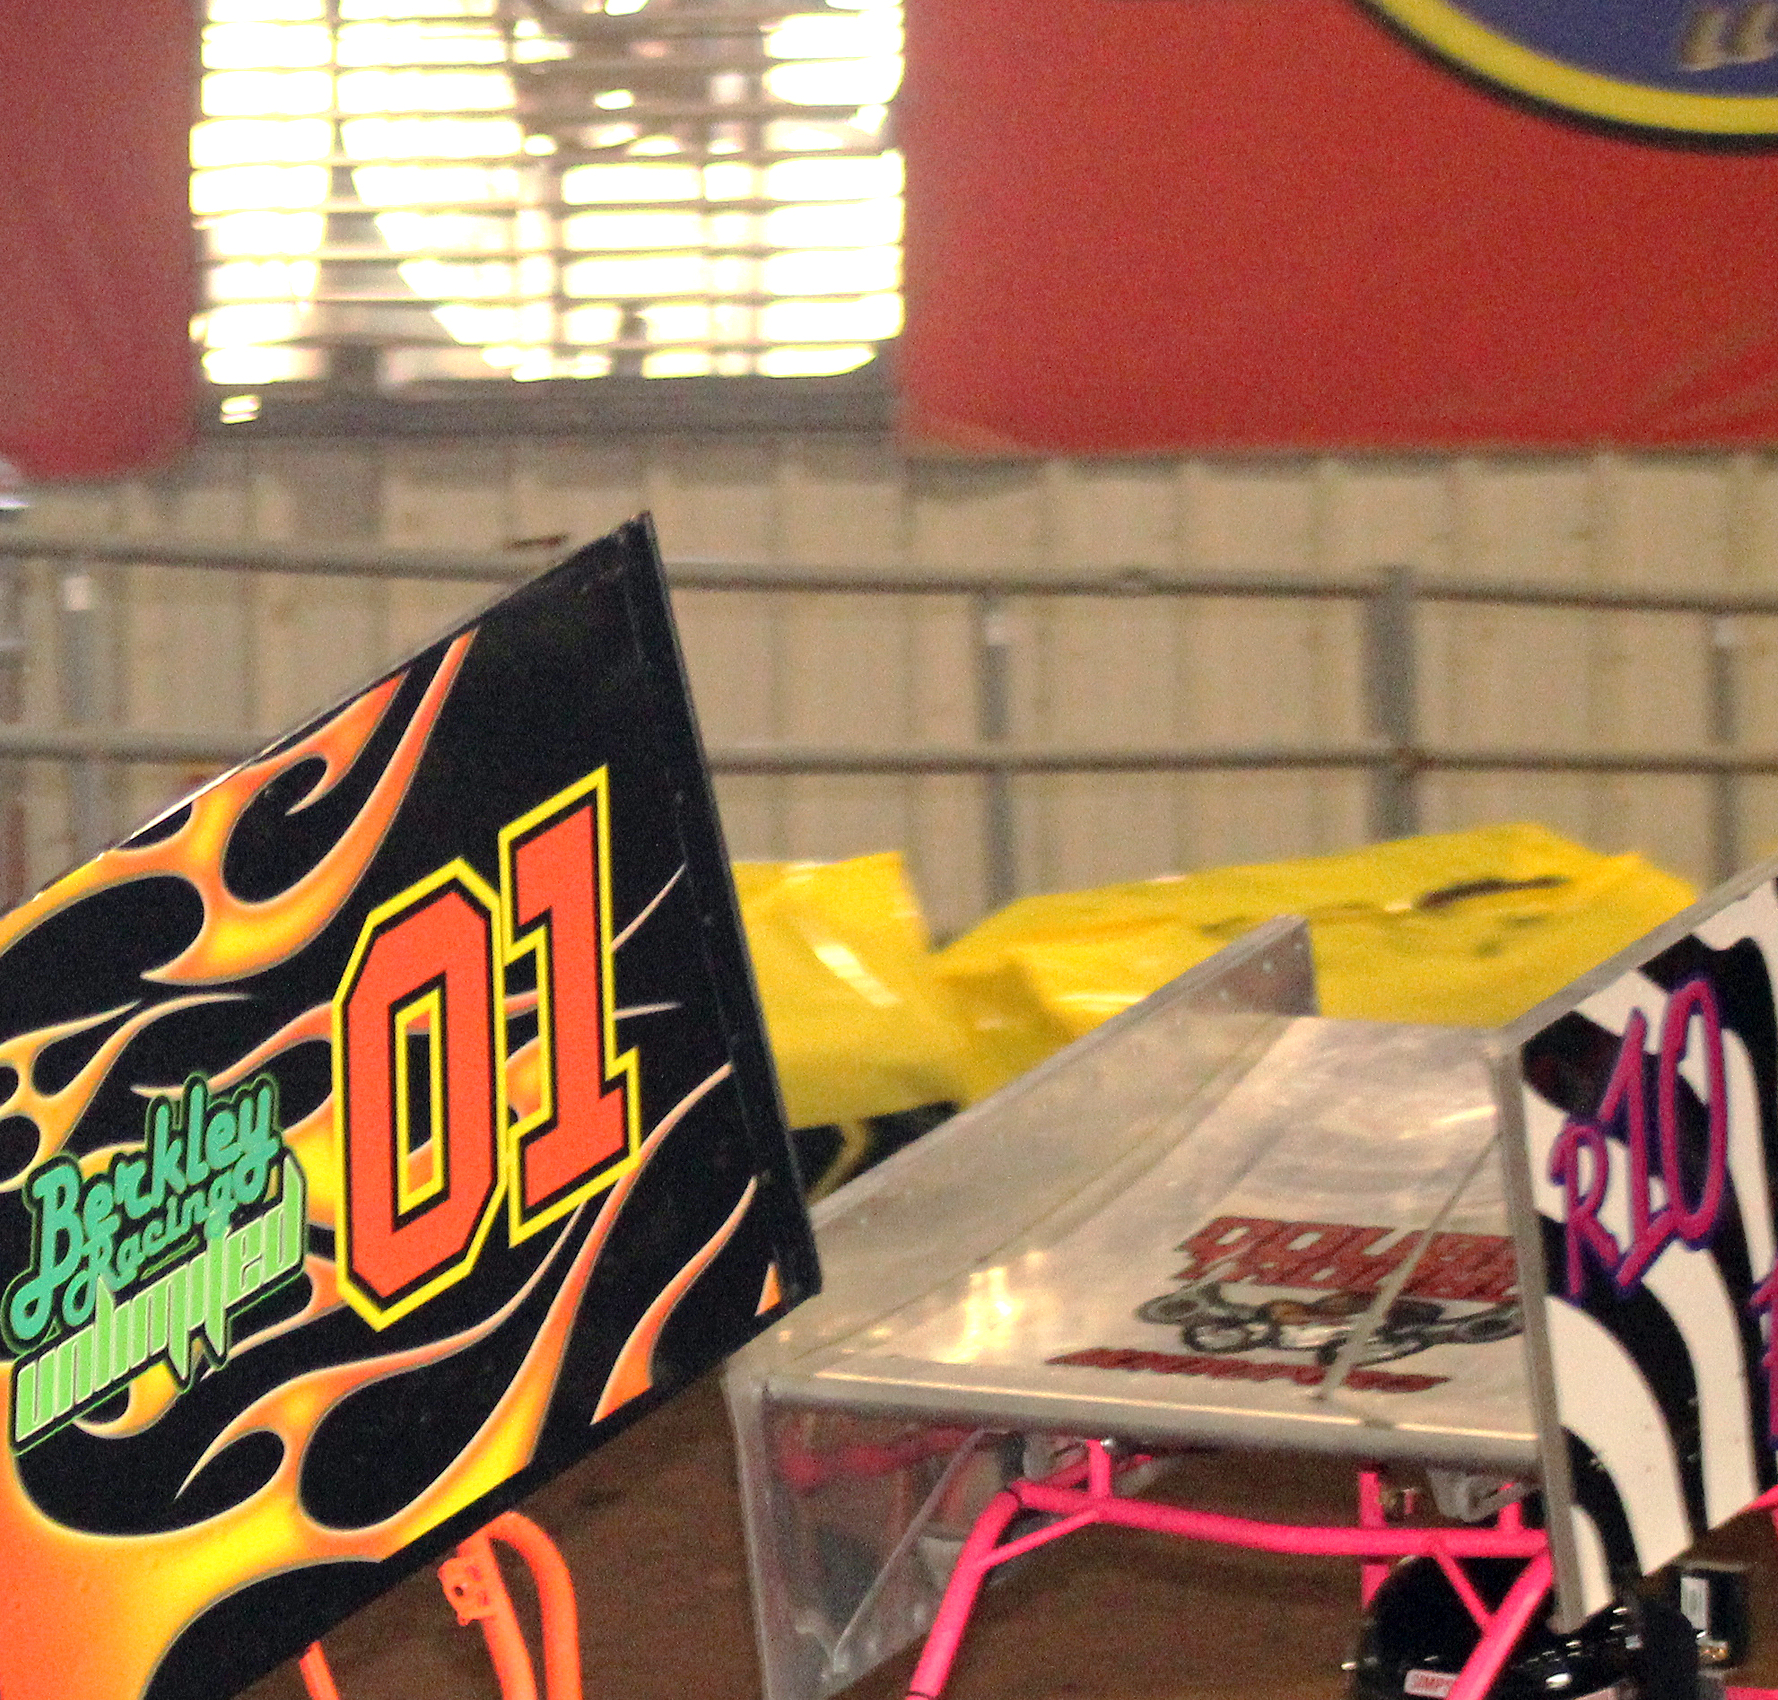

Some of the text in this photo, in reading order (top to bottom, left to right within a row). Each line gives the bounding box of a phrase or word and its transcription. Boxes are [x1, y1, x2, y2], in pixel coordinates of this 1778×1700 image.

[332, 764, 642, 1332] 01
[9, 1083, 280, 1342] Berkley
[60, 1168, 236, 1328] Racing
